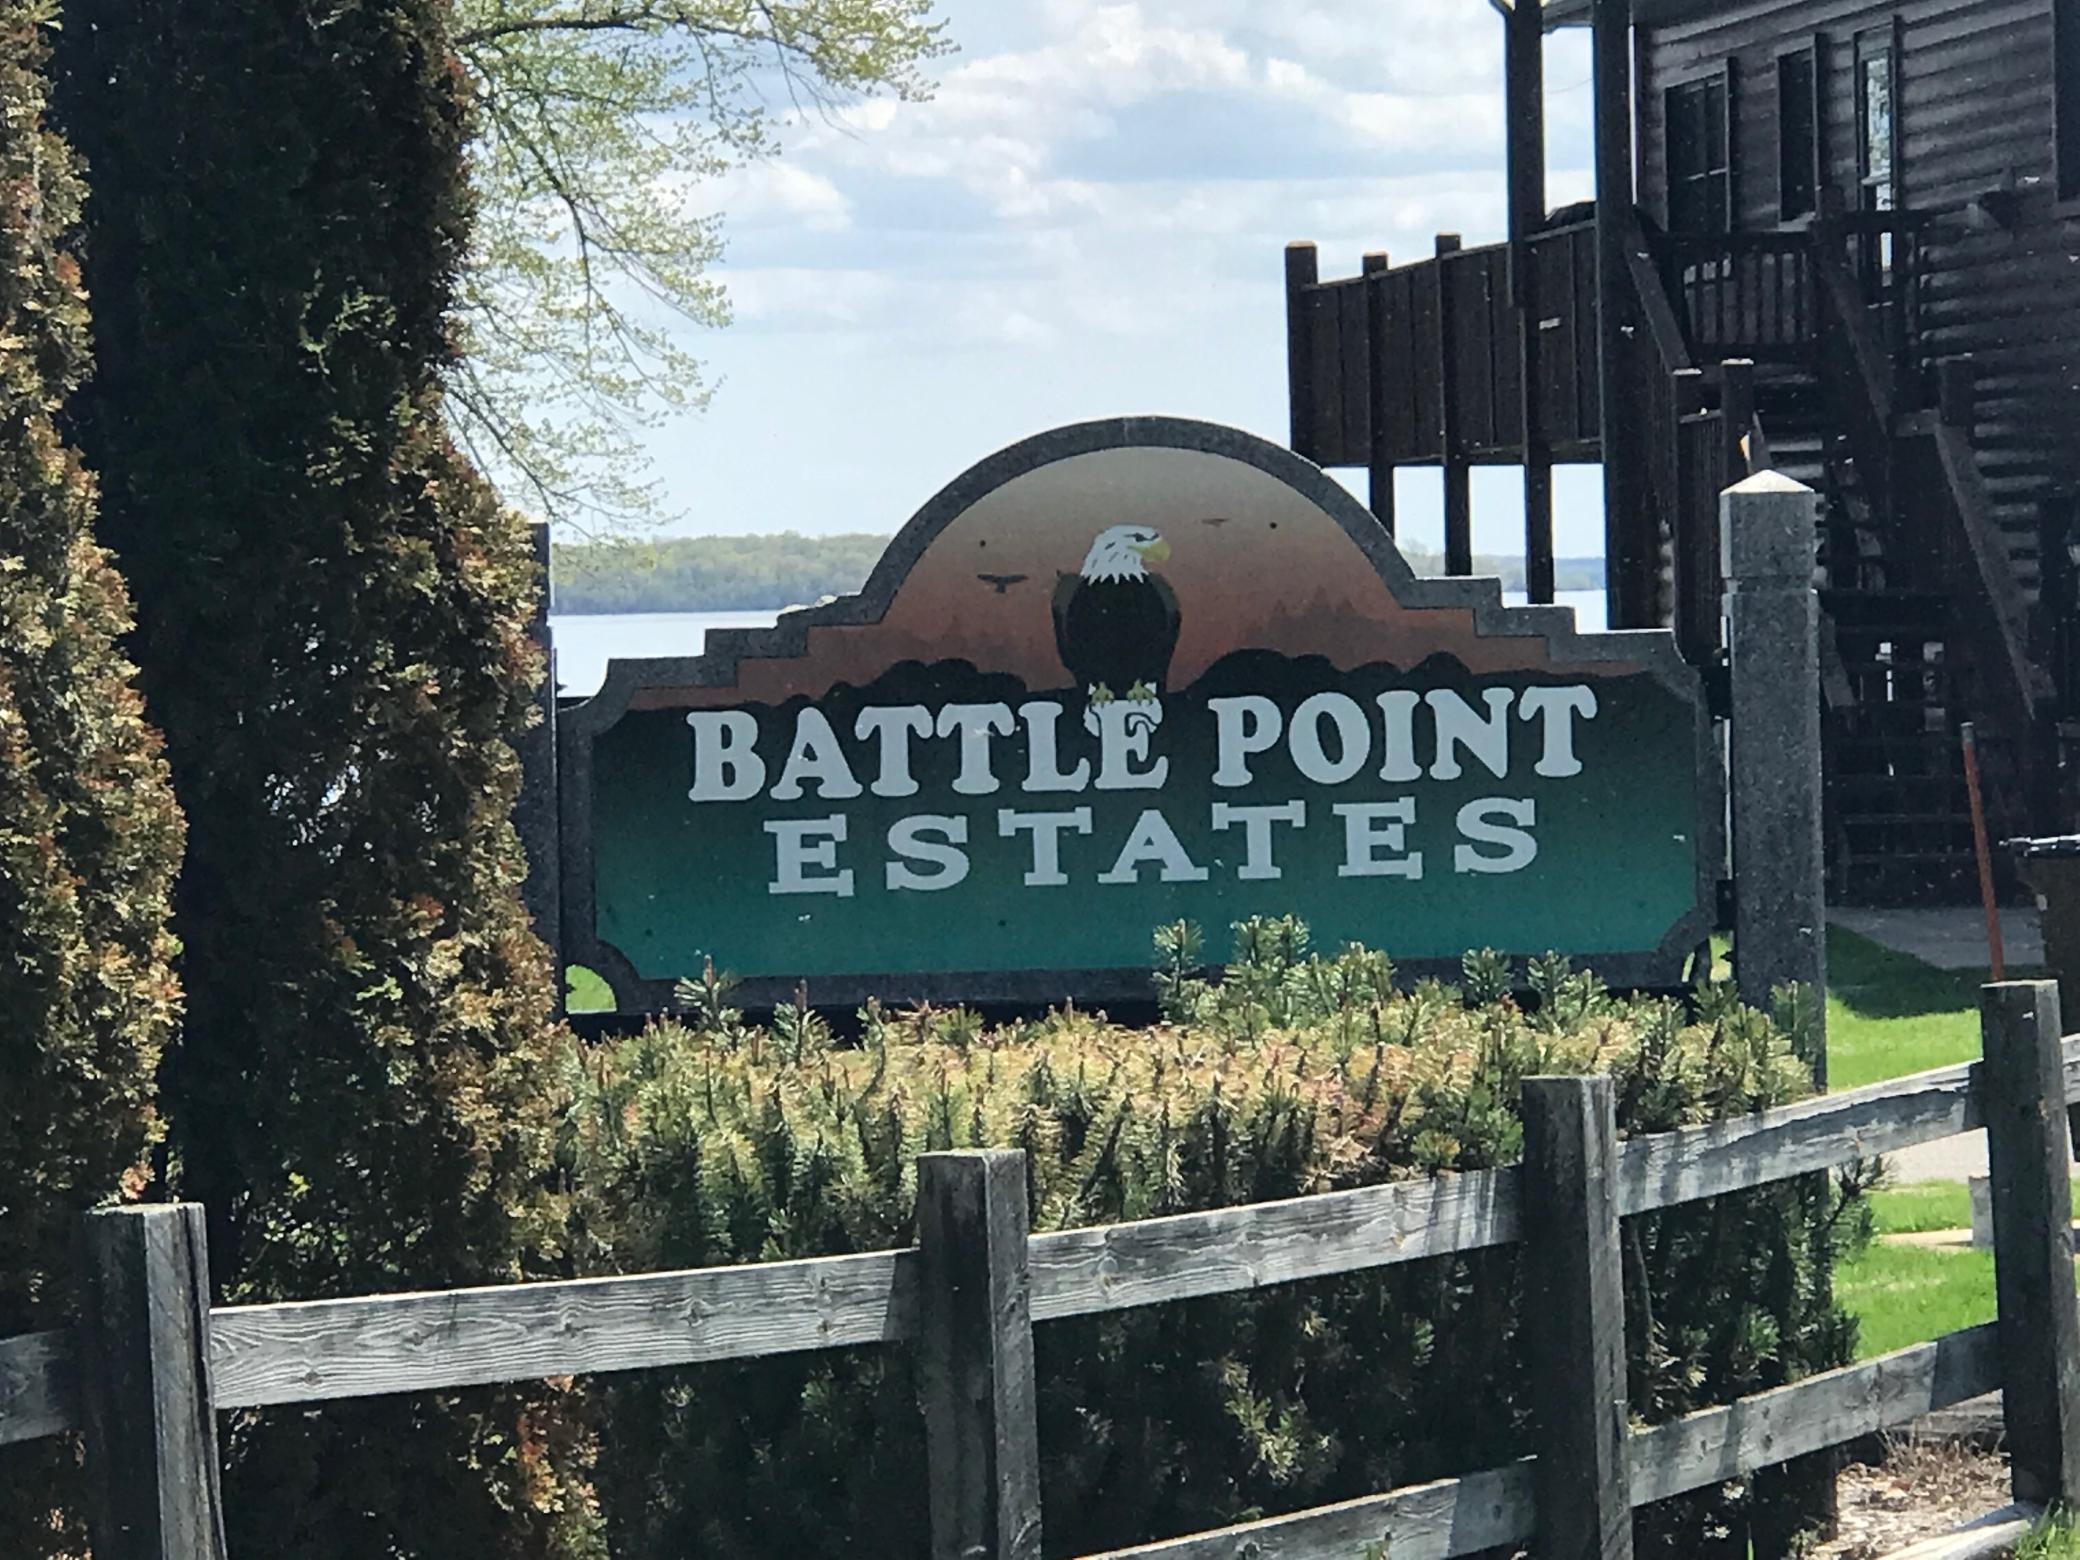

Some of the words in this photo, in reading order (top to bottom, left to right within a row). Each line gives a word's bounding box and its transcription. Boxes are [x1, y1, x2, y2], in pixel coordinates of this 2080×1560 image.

[686, 696, 1169, 803] BATTLE
[1207, 684, 1598, 787] POINT
[763, 796, 1538, 898] ESTATES
